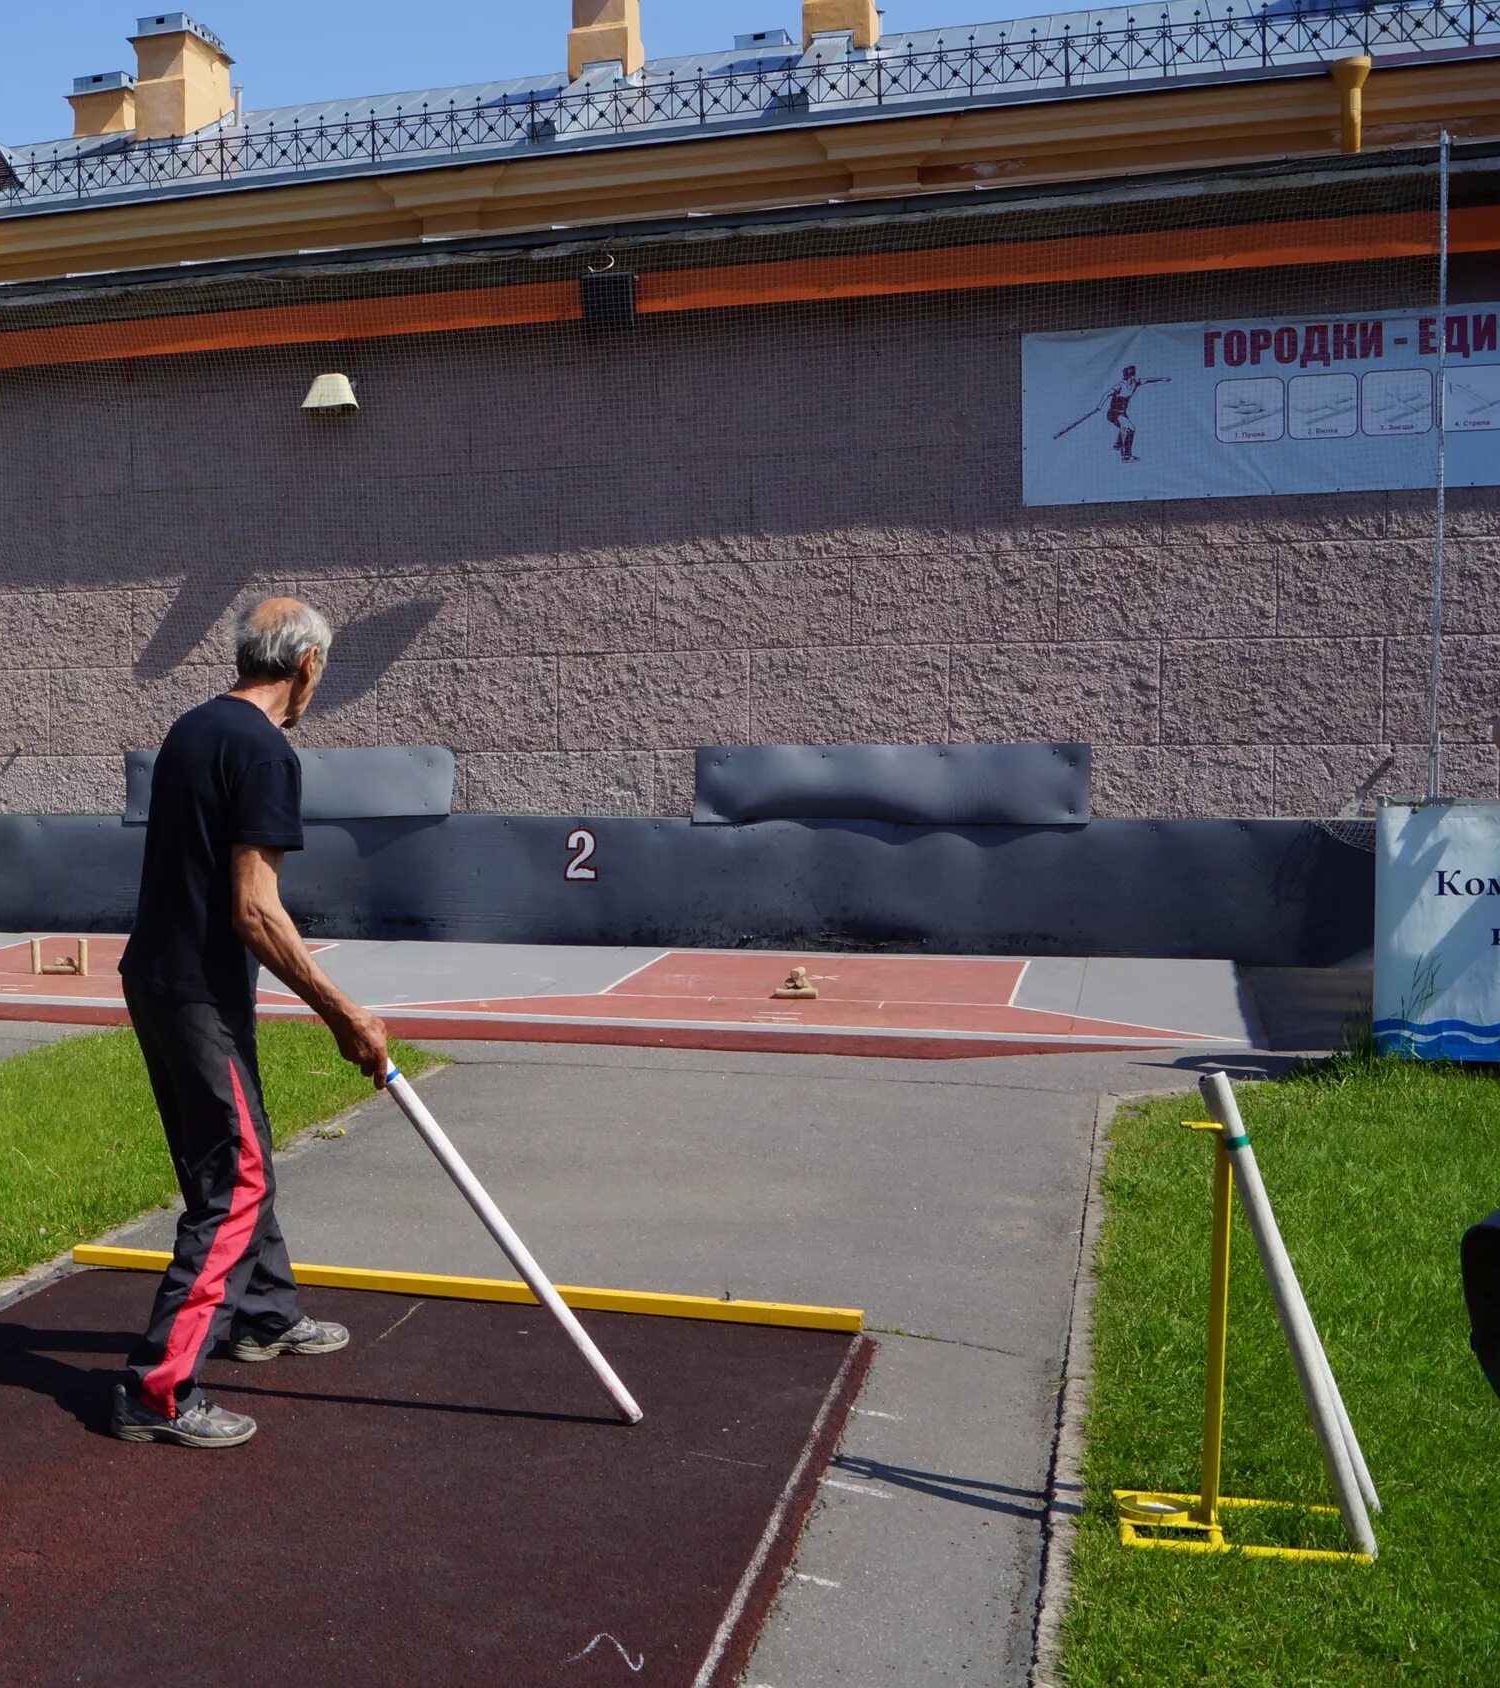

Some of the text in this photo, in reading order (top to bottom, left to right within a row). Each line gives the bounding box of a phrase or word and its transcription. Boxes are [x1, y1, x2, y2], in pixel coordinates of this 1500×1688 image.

[1203, 320, 1383, 368] ГОРОДКИ
[1463, 419, 1491, 427] Стрела
[564, 827, 598, 881] 2
